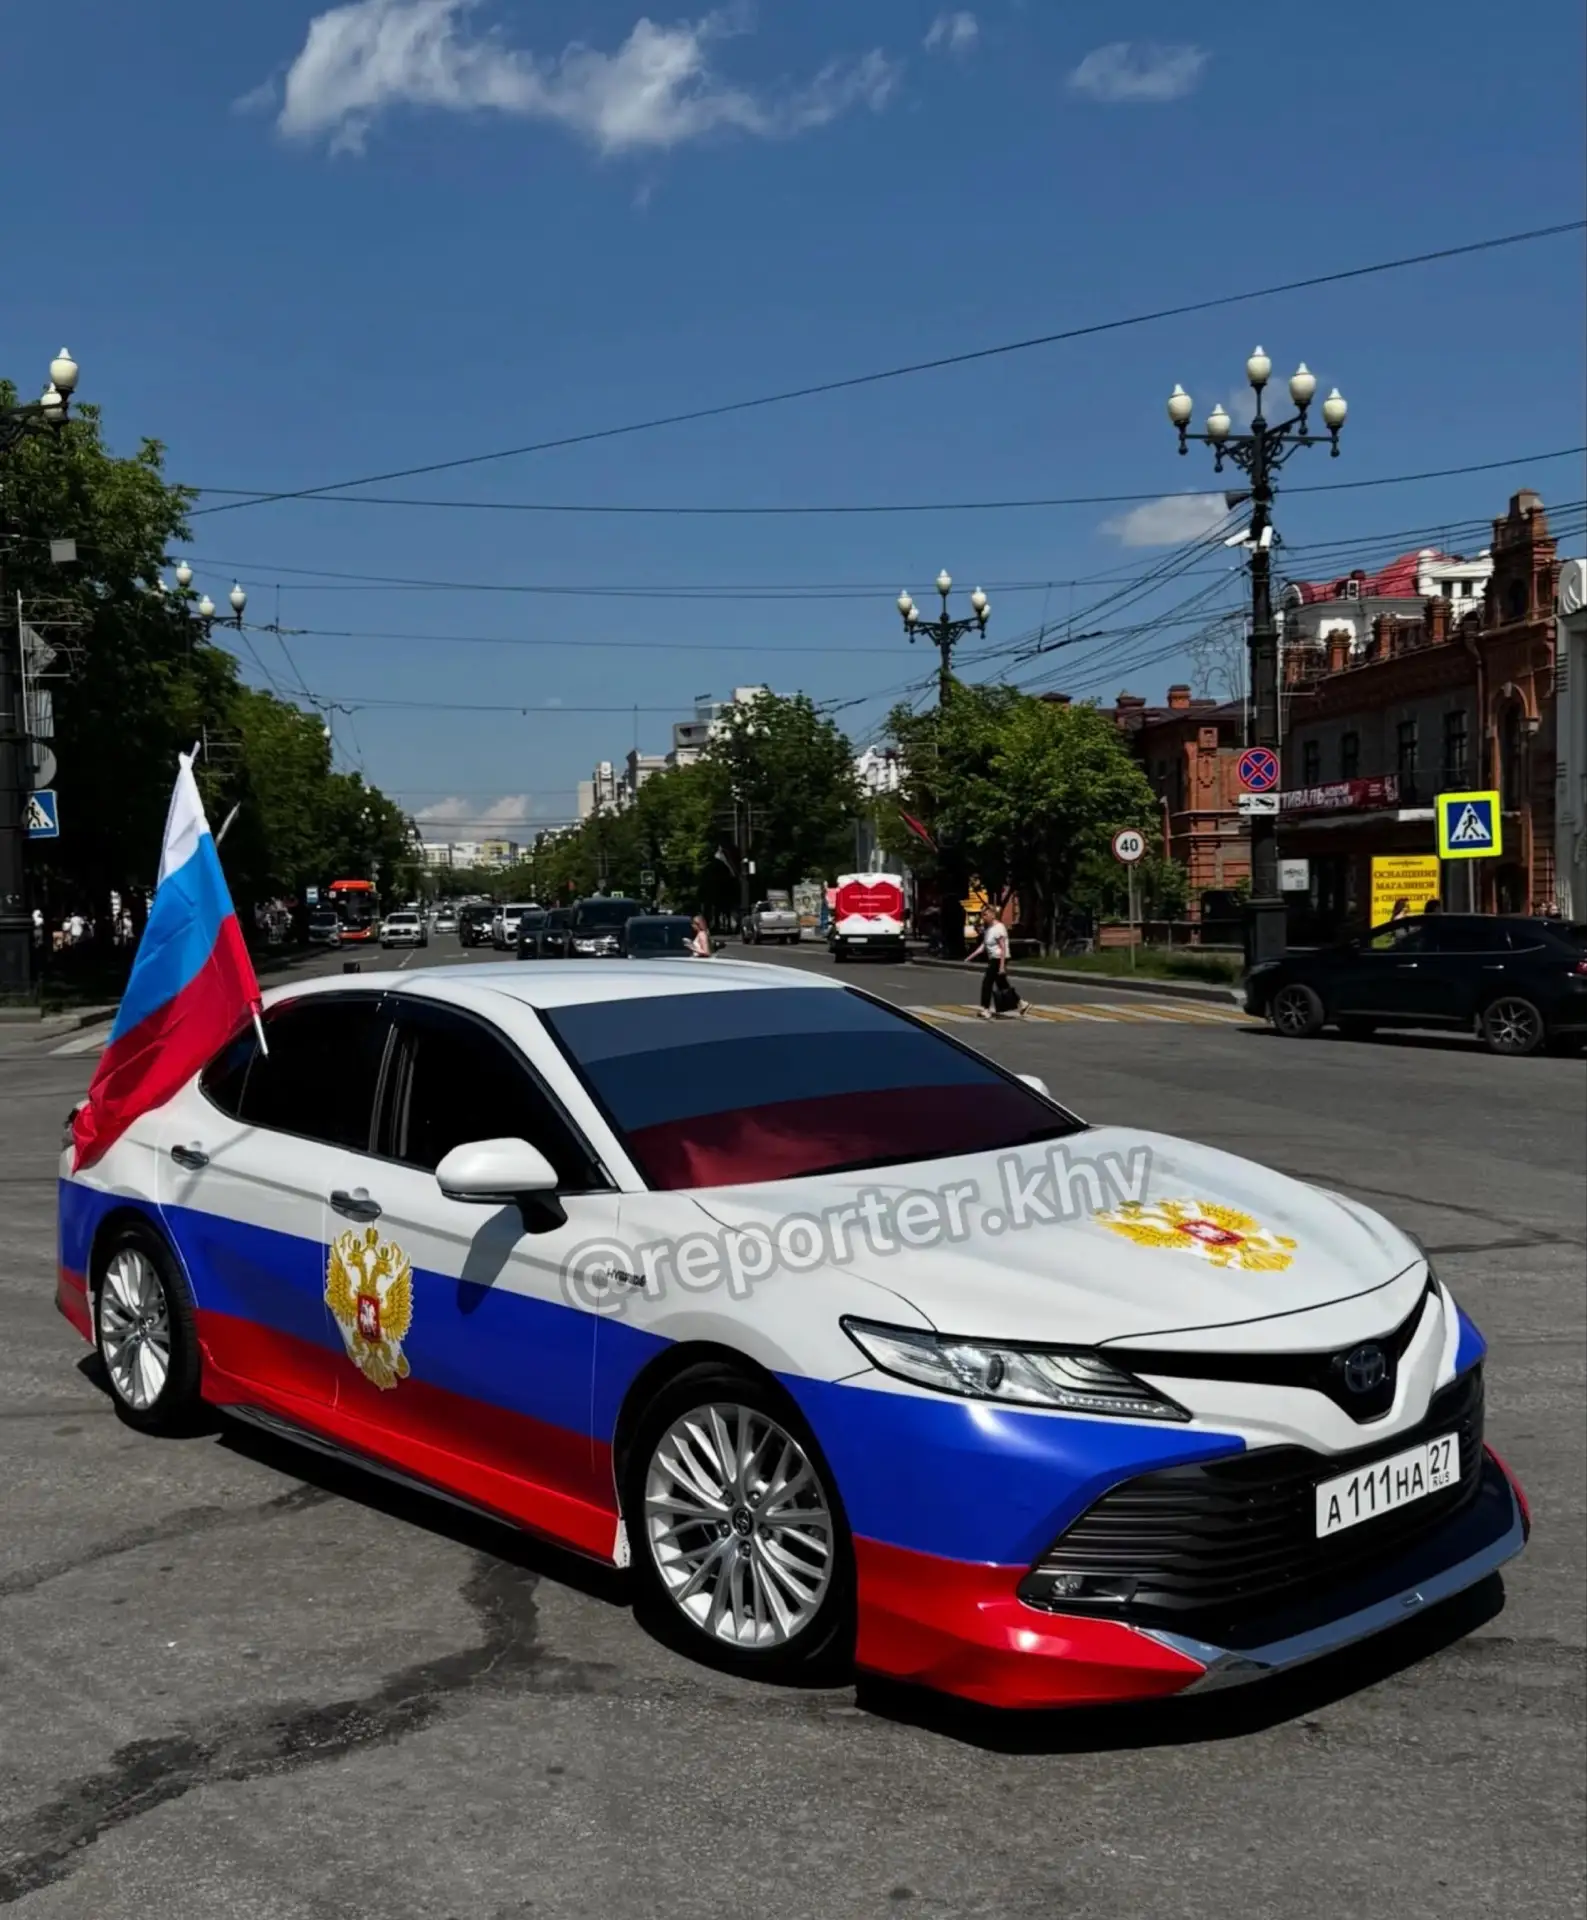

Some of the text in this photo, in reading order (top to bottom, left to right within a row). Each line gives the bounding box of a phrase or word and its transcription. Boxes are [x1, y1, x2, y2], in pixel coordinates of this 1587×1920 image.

[1280, 787, 1325, 809] ТИВАЛЬ
[1120, 838, 1139, 852] 40
[1430, 1439, 1451, 1475] 27
[1432, 1471, 1450, 1487] RUS
